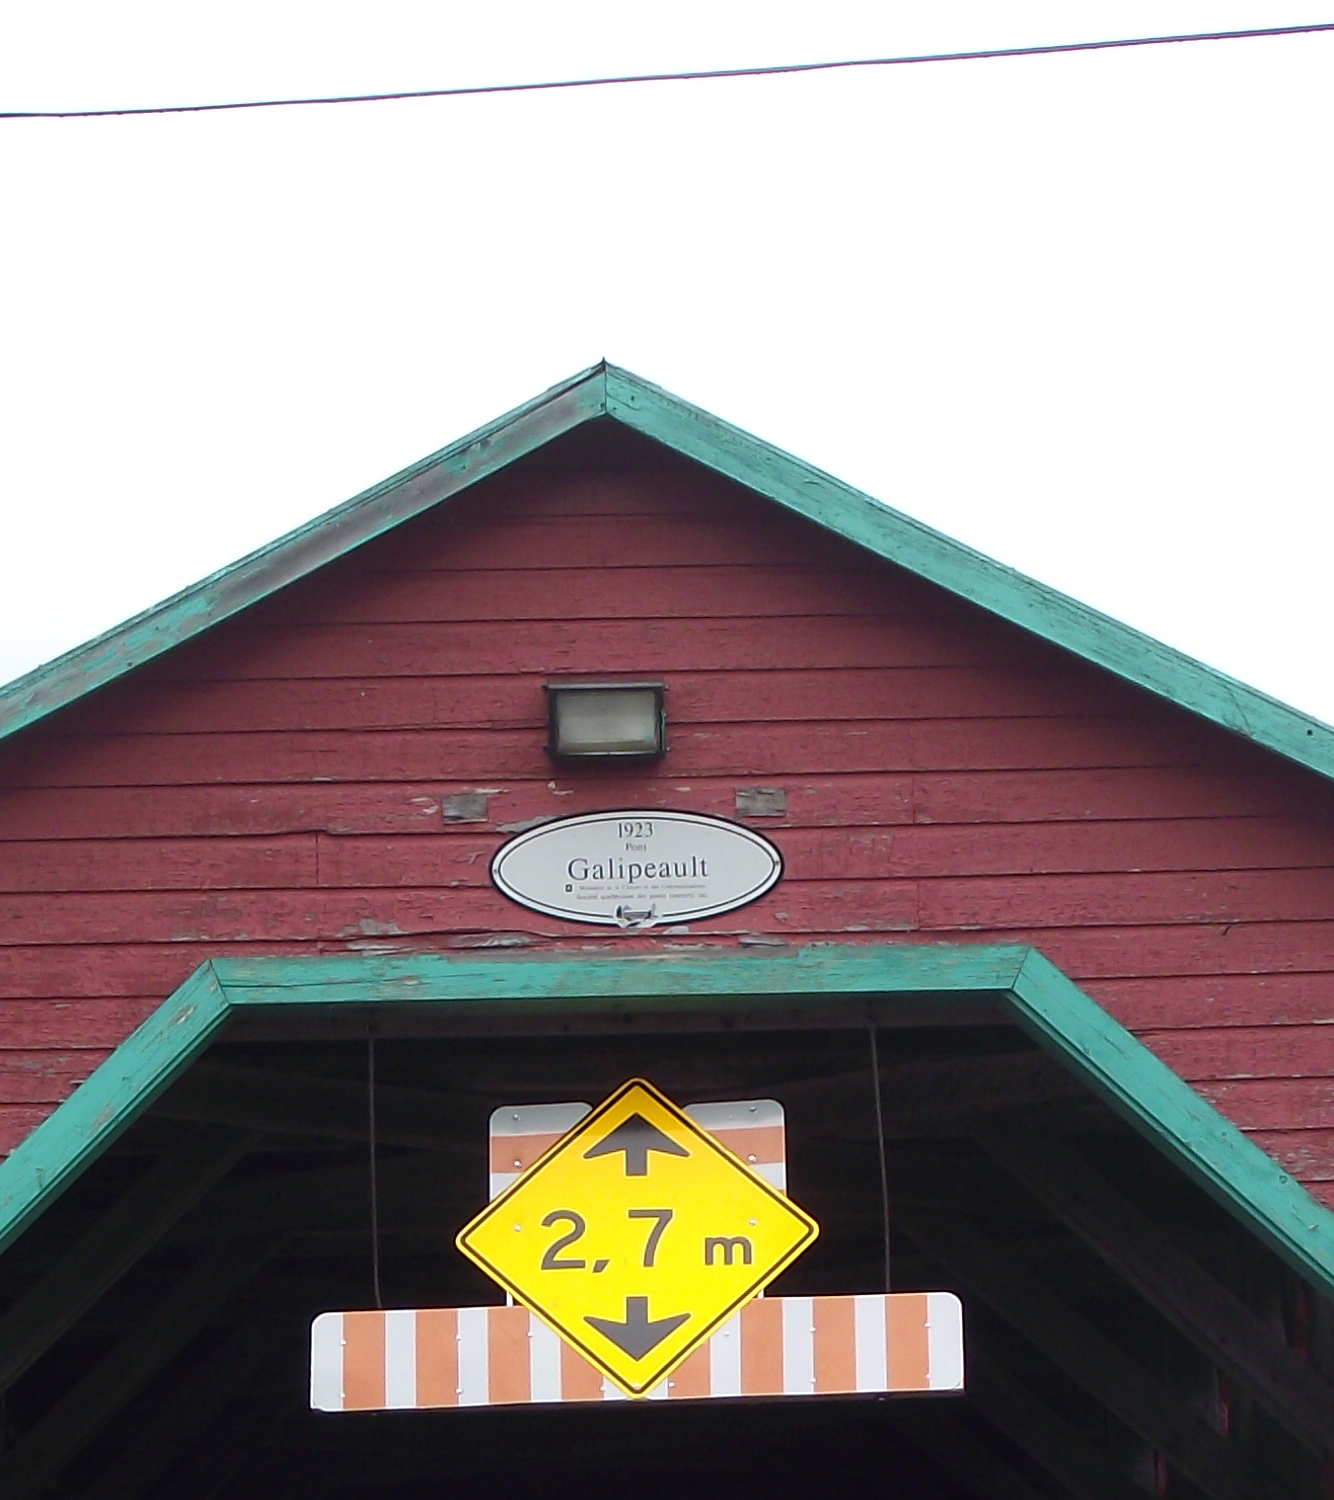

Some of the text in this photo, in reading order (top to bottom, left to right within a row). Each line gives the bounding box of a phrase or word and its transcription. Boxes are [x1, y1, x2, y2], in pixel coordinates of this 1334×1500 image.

[617, 822, 654, 839] 1923
[625, 842, 647, 852] Pont
[567, 855, 708, 884] Galipeault
[539, 1208, 753, 1274] 2,7 m
